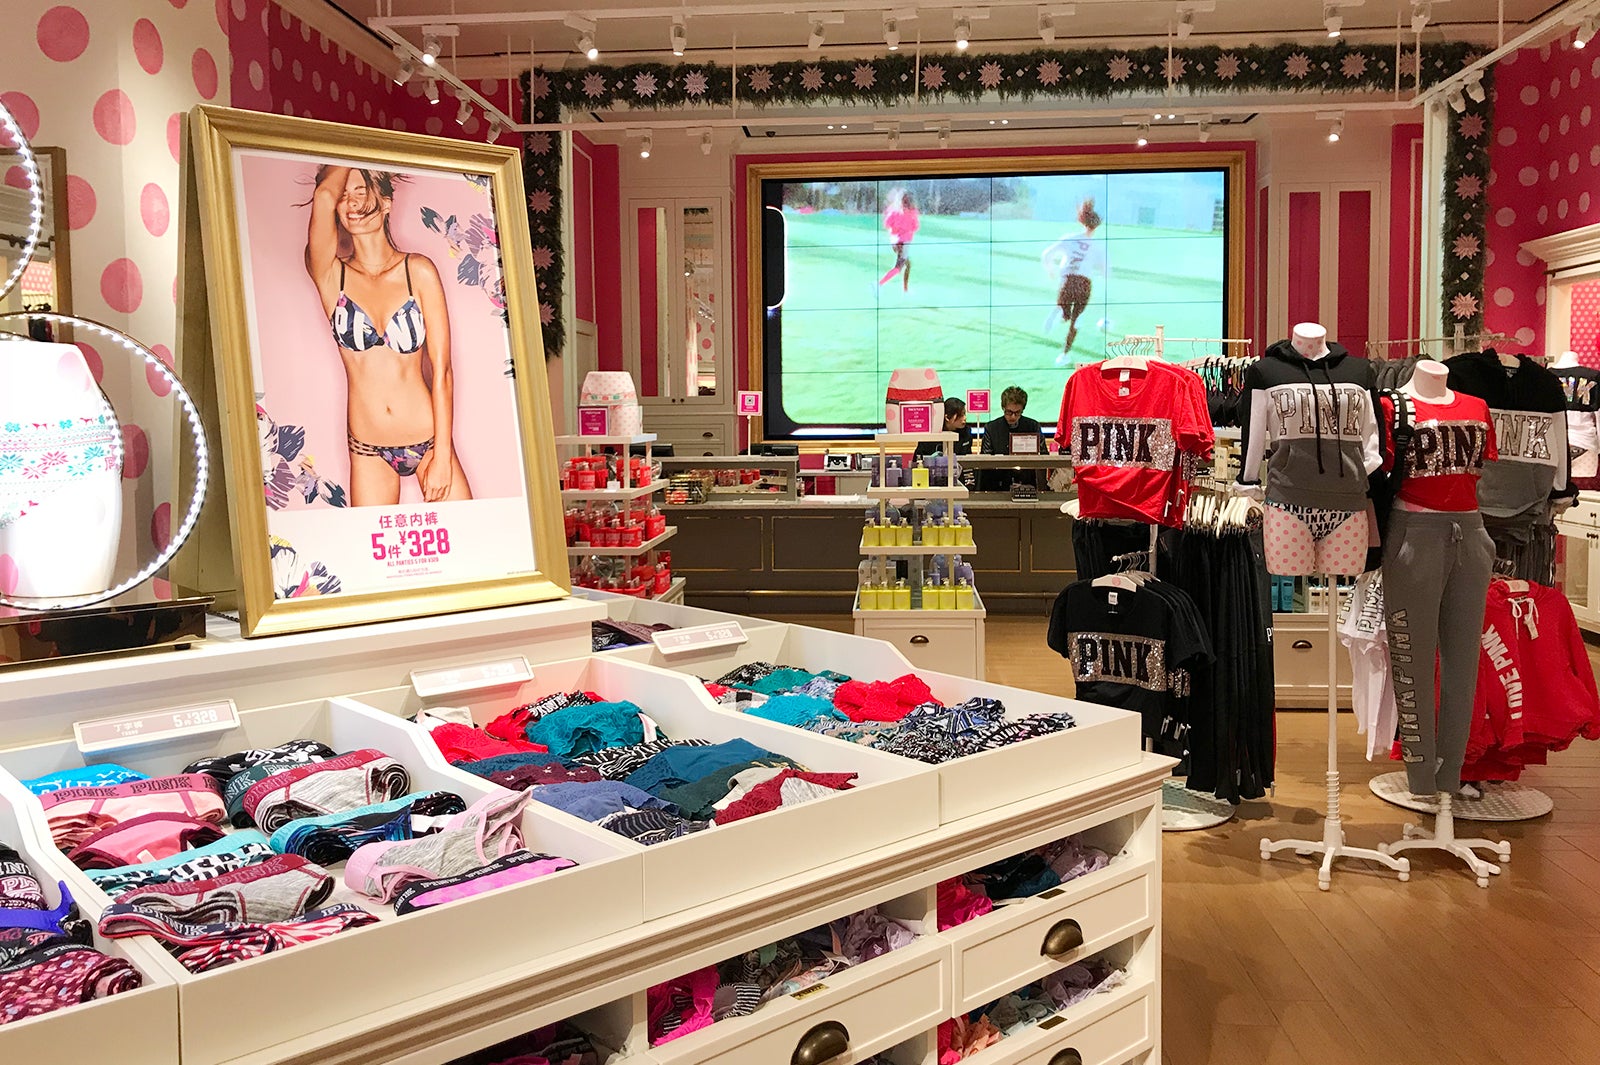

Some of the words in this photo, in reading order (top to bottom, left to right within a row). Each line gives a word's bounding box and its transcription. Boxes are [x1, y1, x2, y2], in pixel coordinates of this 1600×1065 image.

[1271, 388, 1367, 436] PINK
[1079, 422, 1157, 463] PINK
[378, 511, 439, 529] 任意内裤
[1077, 638, 1152, 682] PINK
[1481, 624, 1514, 672] PINK
[53, 786, 120, 802] PINK
[130, 776, 193, 794] PINK
[212, 856, 289, 887] PINK
[132, 904, 208, 936] PINK
